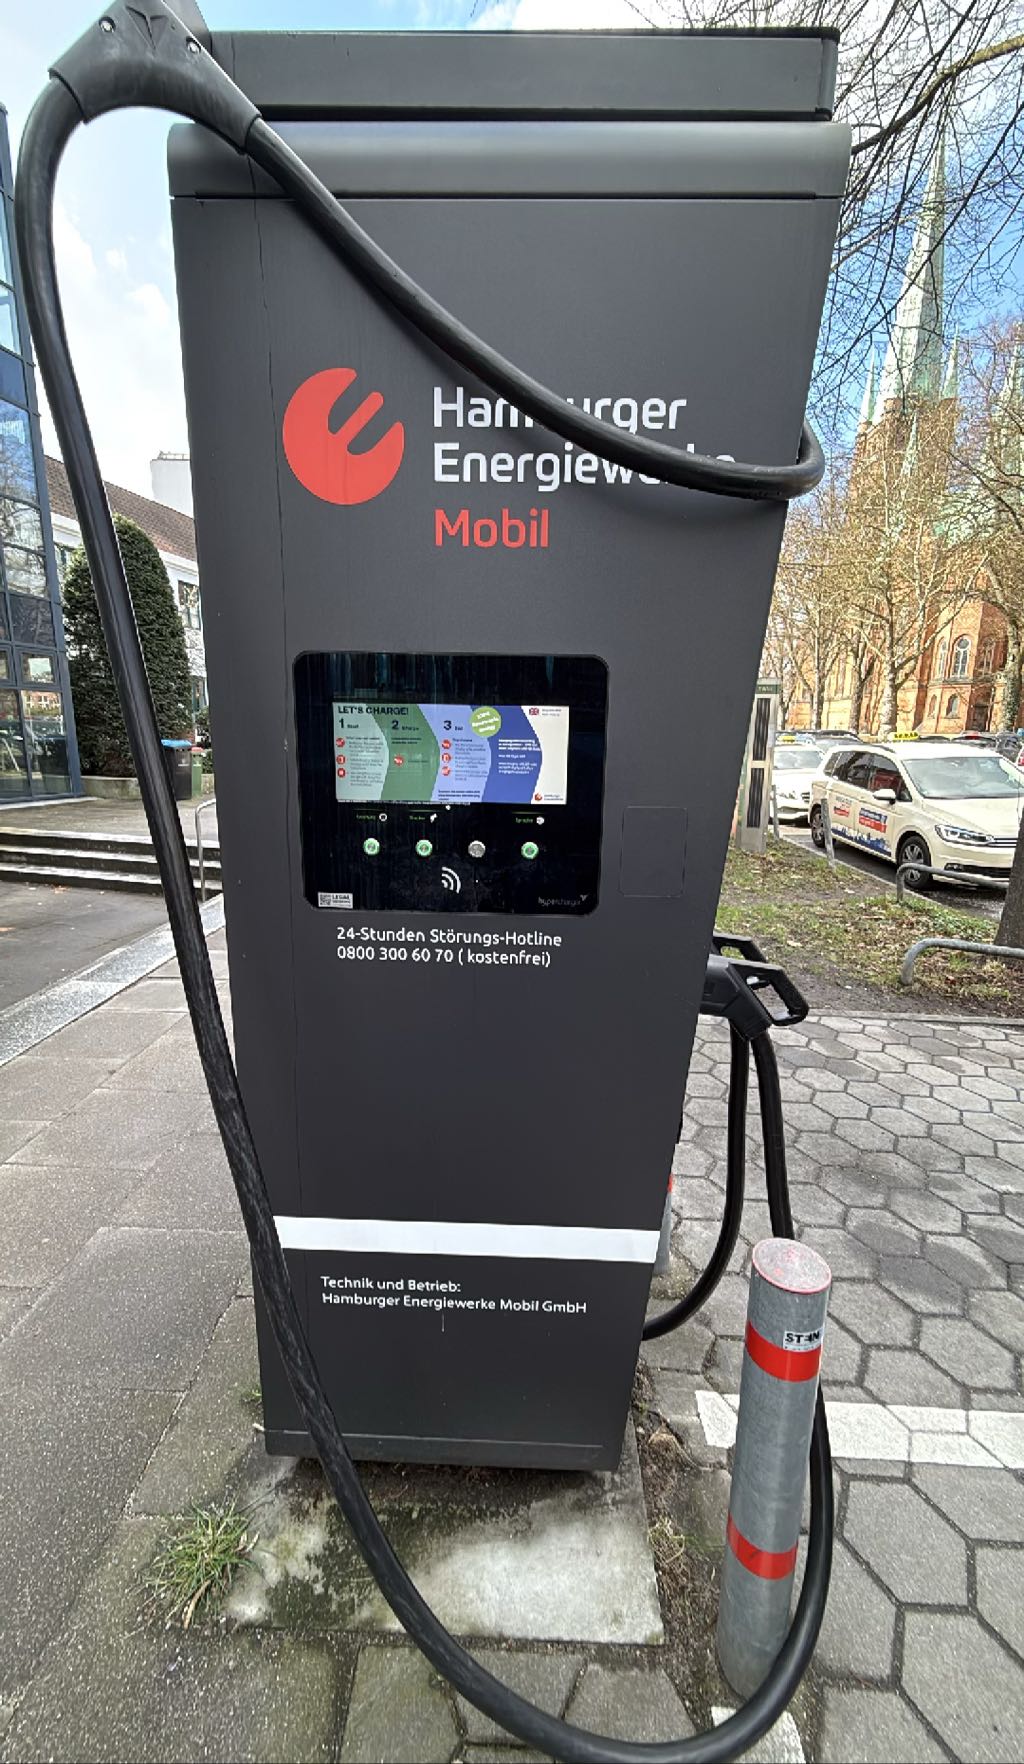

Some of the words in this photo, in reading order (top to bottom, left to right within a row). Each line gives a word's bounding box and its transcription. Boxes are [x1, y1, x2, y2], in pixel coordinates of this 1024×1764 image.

[433, 386, 687, 435] Hamrger
[433, 441, 736, 492] Energiew
[433, 508, 550, 548] Mobil
[365, 707, 409, 715] CHARGE!
[339, 718, 344, 729] 1
[391, 720, 399, 730] 2
[443, 720, 452, 731] 3
[337, 927, 425, 943] 24-Stunden
[430, 929, 562, 947] Störungs-Hotline
[337, 945, 375, 960] 0800
[379, 947, 407, 961] 300
[411, 948, 431, 962] 60
[435, 949, 453, 963] 70
[320, 1276, 374, 1289] Technik
[377, 1278, 405, 1291] und
[408, 1280, 461, 1293] Betrieb:
[321, 1293, 401, 1309] Hamburger
[404, 1295, 496, 1311] Energiewerke
[500, 1299, 540, 1312] Mobil
[542, 1301, 587, 1314] GmbH
